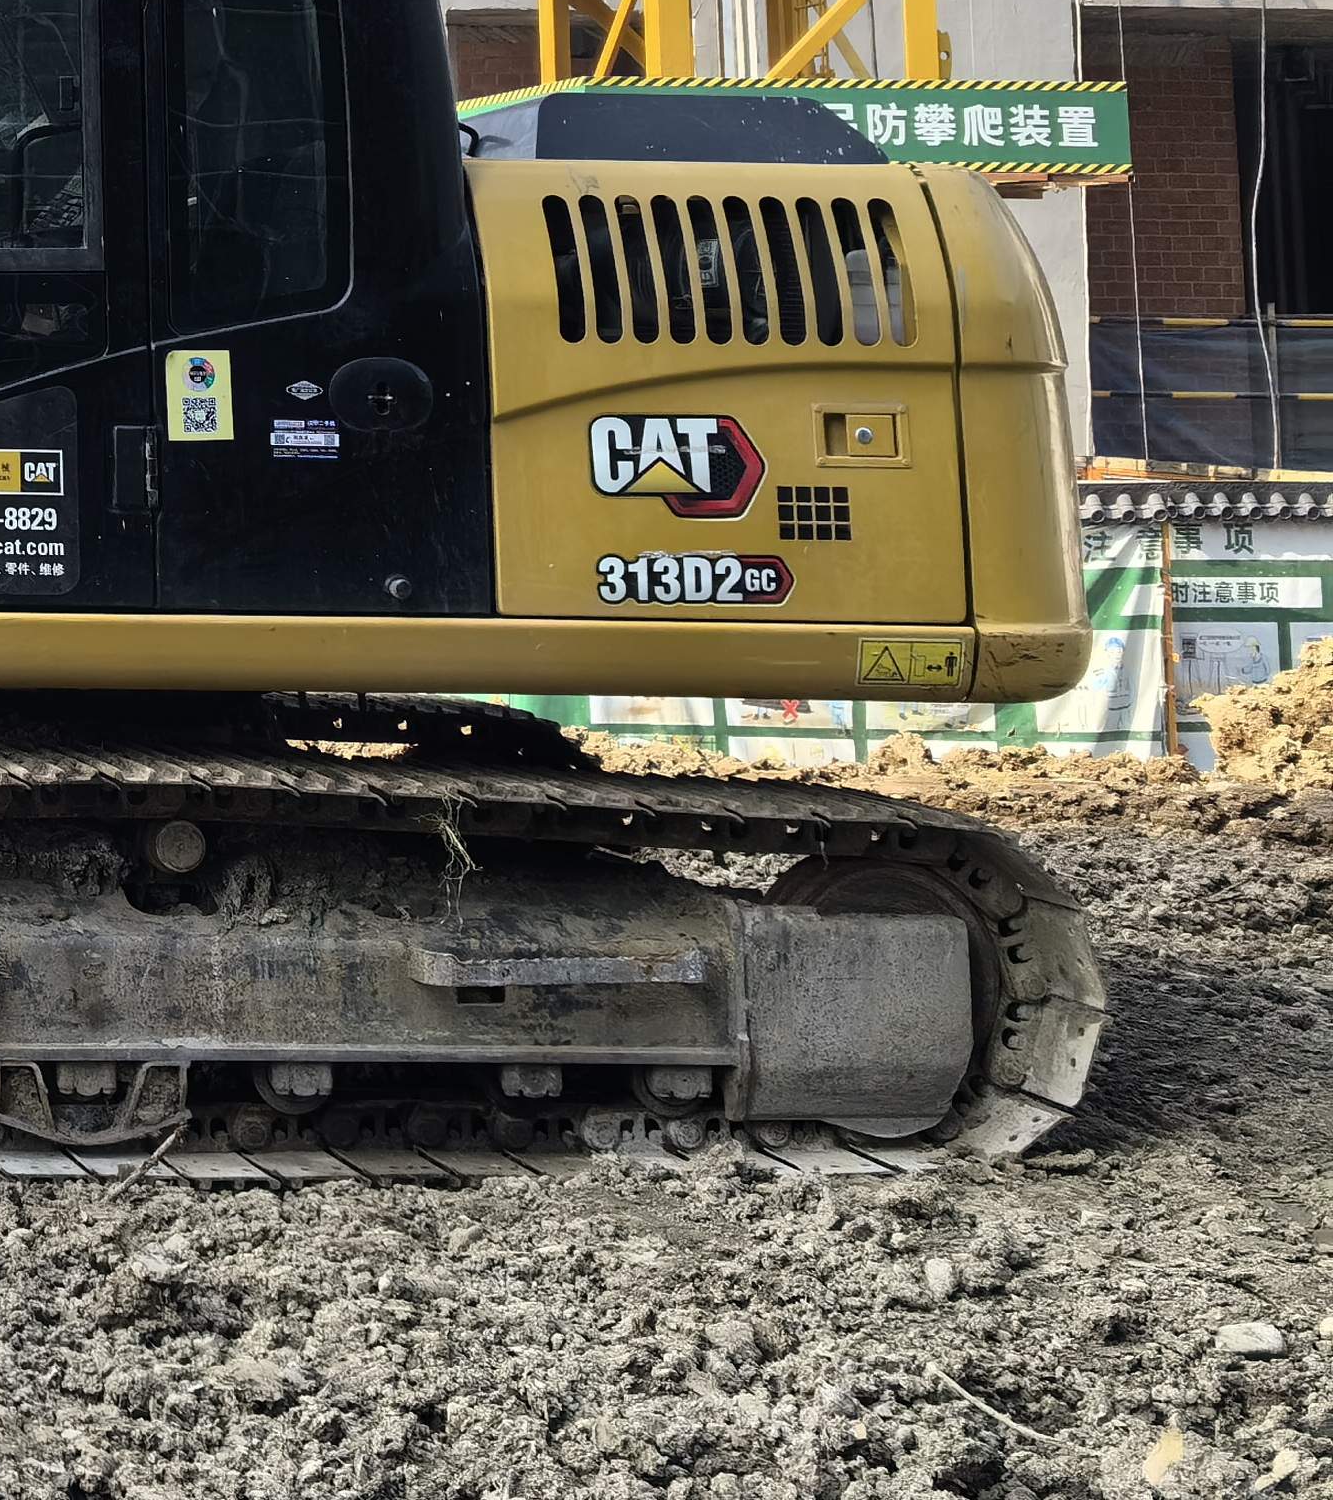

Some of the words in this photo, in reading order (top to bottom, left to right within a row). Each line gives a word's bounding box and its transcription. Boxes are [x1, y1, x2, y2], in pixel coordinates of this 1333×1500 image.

[23, 462, 57, 484] CAT
[590, 415, 718, 494] CAT
[598, 556, 744, 602] 313D2
